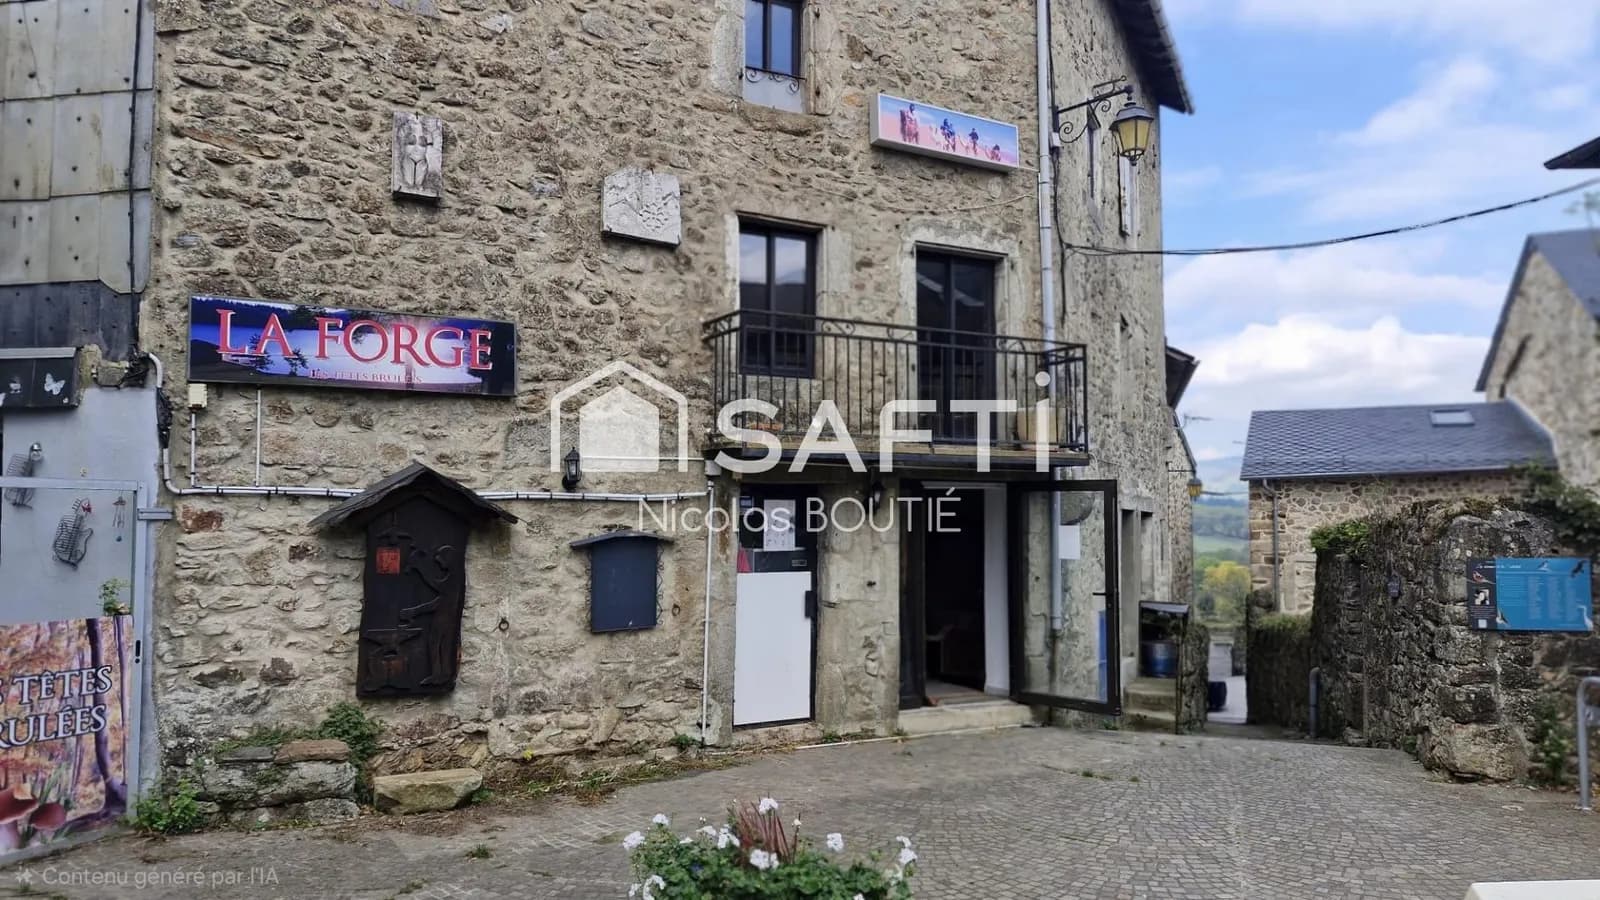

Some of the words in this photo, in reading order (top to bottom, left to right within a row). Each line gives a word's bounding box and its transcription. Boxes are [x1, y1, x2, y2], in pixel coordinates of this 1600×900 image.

[216, 308, 299, 360] LA
[314, 316, 493, 371] FORGE
[12, 665, 113, 705] TÊTES
